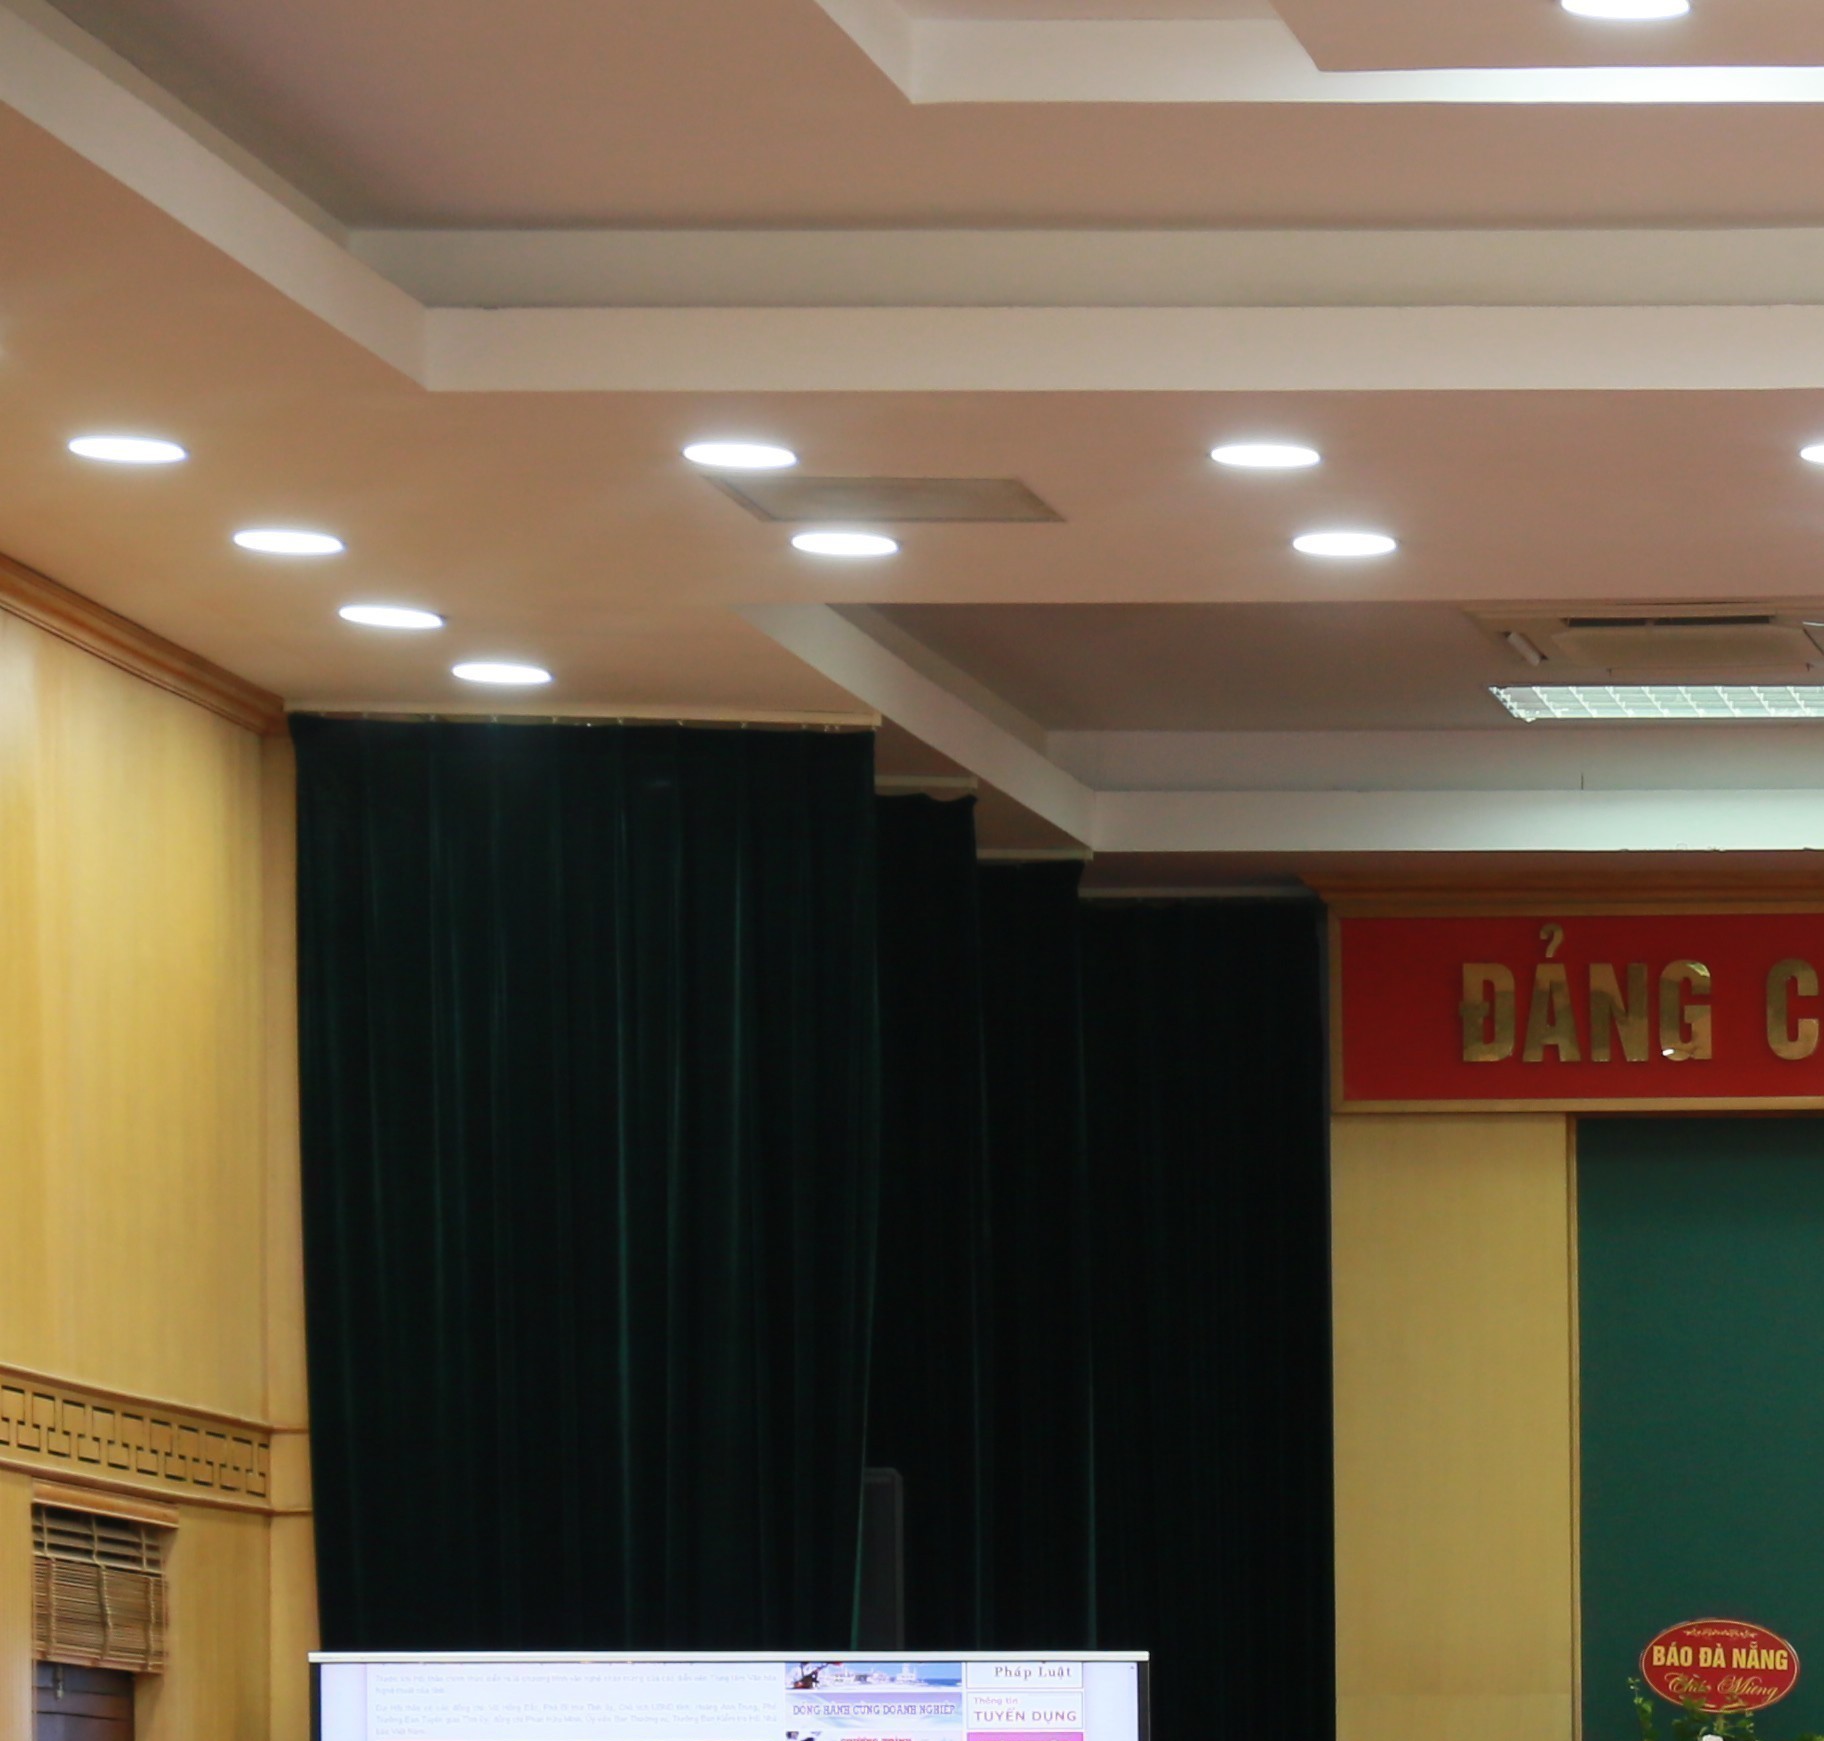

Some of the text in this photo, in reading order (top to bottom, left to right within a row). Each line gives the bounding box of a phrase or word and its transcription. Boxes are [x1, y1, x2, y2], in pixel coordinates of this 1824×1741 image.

[1460, 921, 1712, 1062] ĐẢNG
[1653, 1640, 1789, 1670] BÁO ĐÀ NẴNG
[994, 1665, 1032, 1680] Pháp
